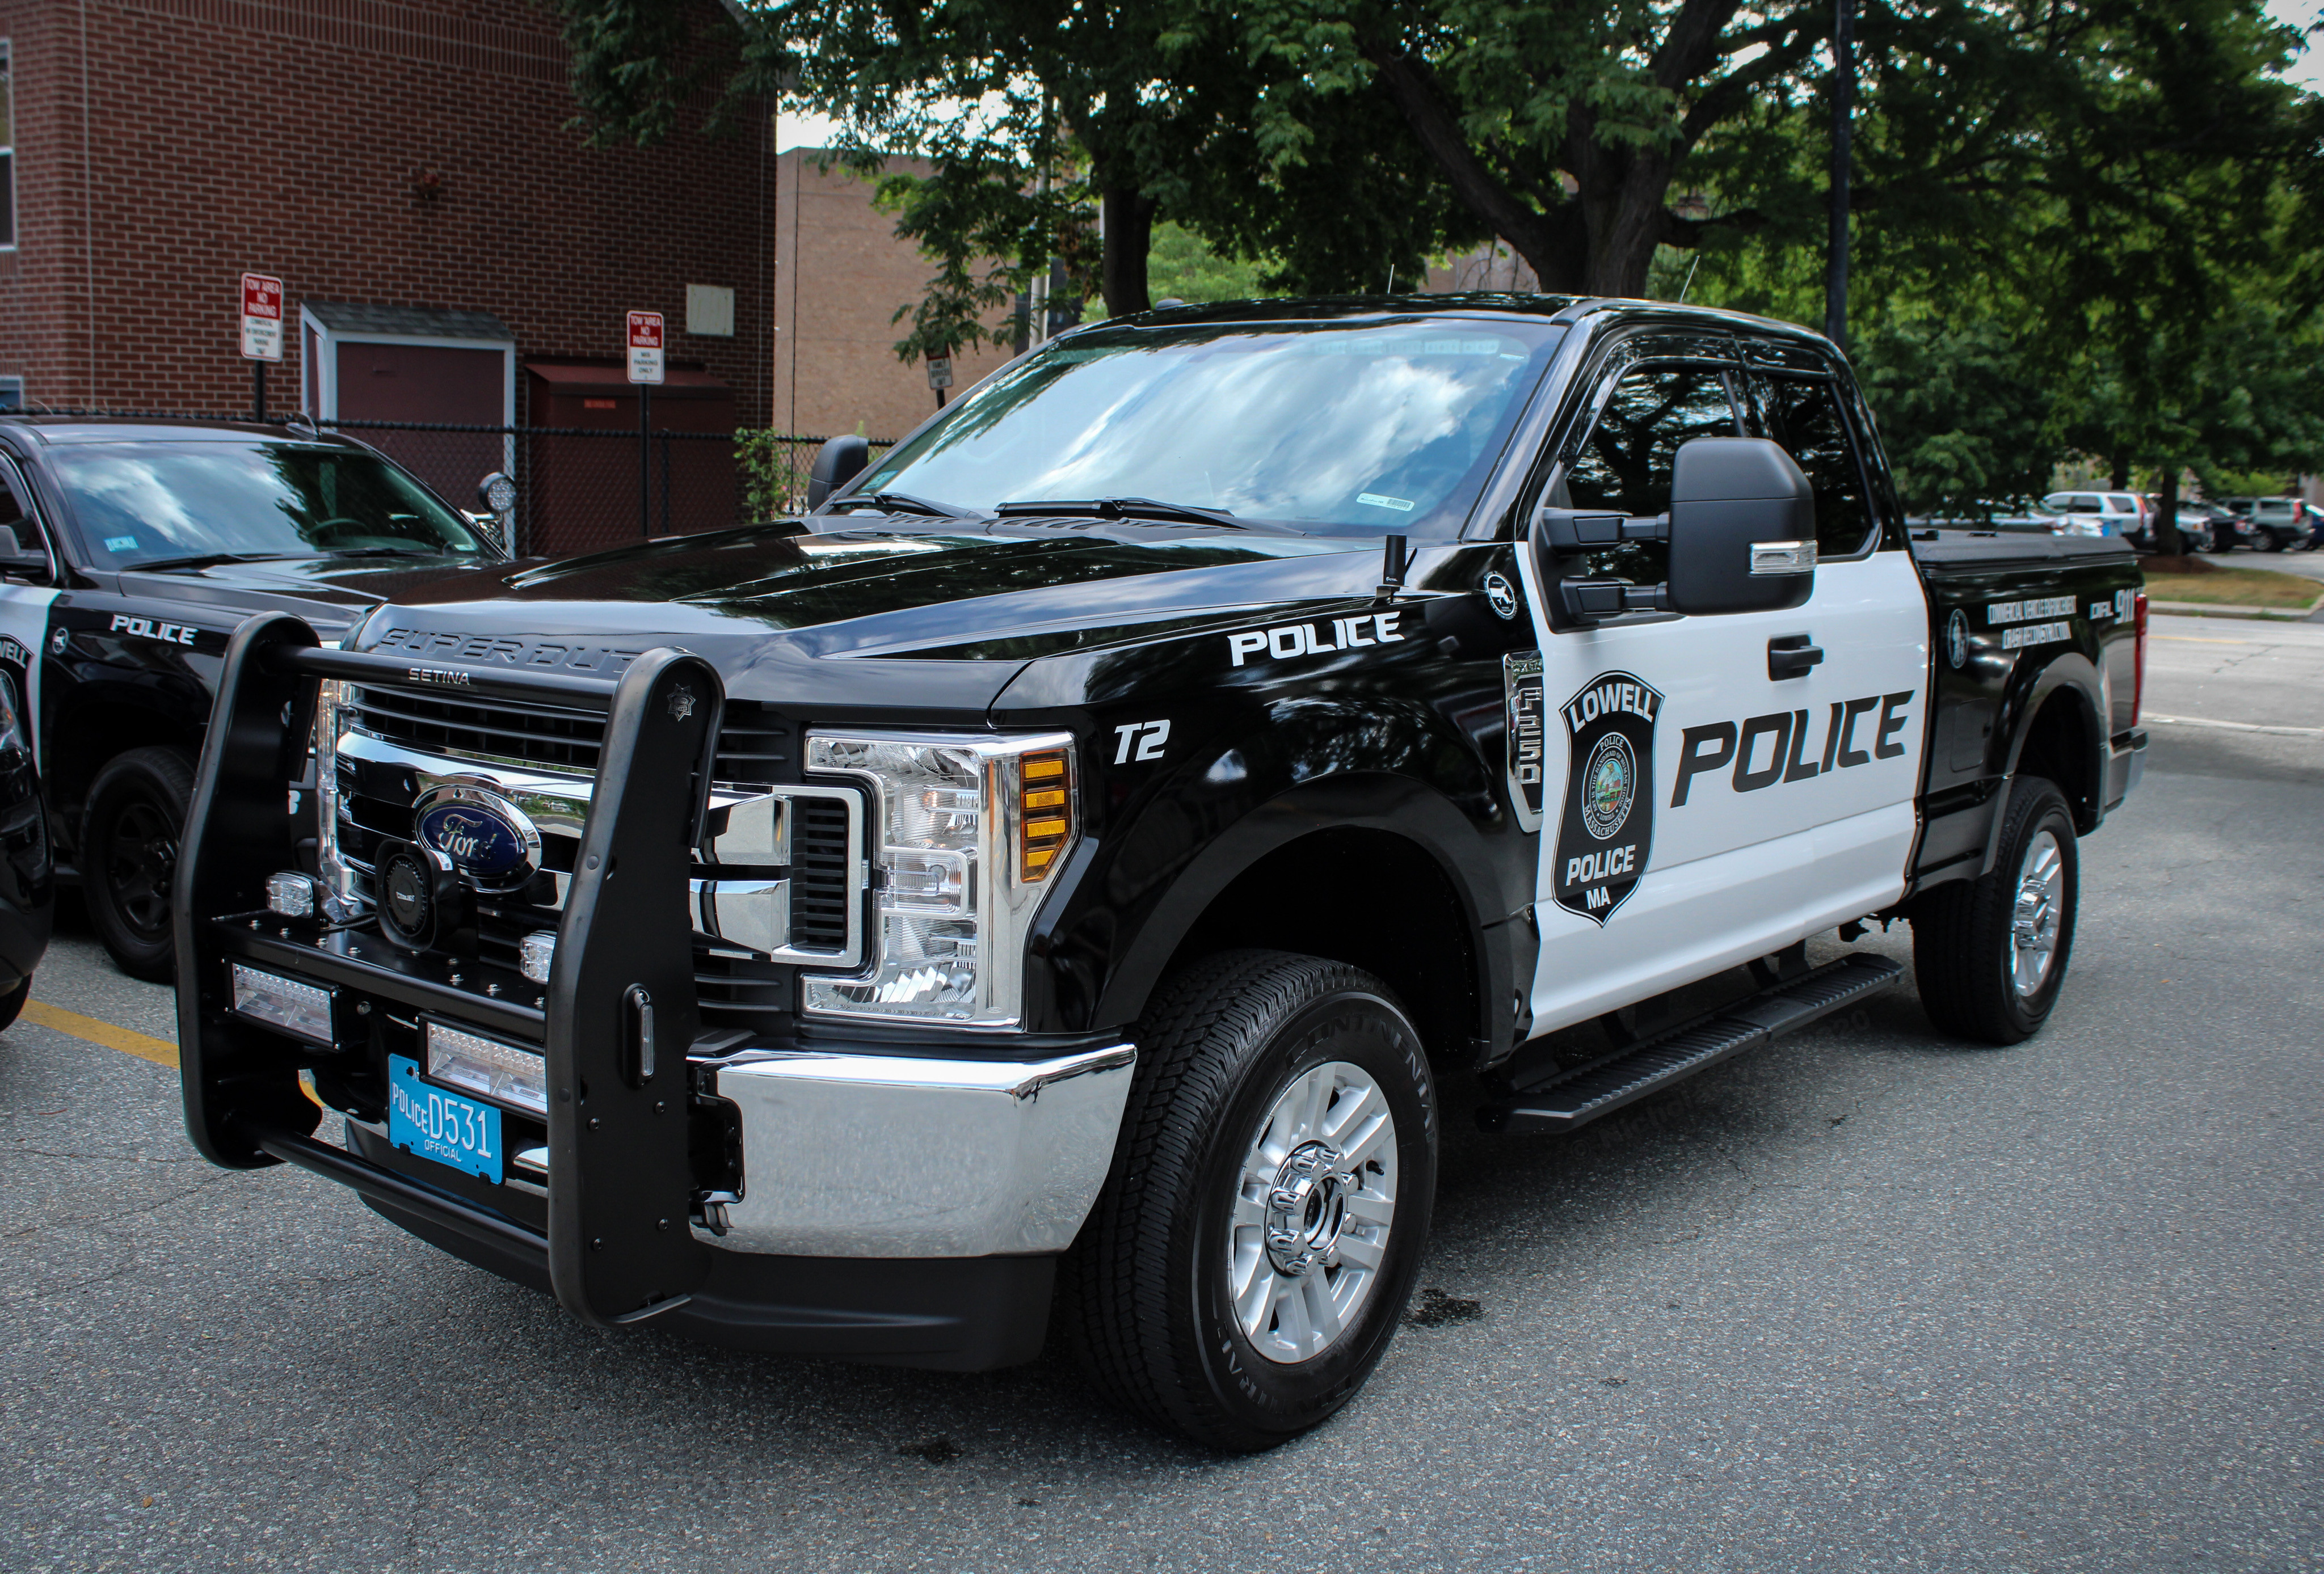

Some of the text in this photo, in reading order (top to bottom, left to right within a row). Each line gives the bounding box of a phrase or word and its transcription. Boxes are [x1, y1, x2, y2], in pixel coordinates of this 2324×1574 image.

[246, 278, 280, 294] TOW AREA
[256, 292, 268, 304] NO
[247, 301, 277, 317] PARKING
[630, 315, 660, 327] TOW AREA
[633, 335, 658, 347] PARKING
[641, 326, 650, 336] NO
[2114, 588, 2136, 624] 911
[110, 614, 199, 645] POLICE
[1227, 611, 1405, 666] POLICE
[380, 628, 642, 673] SUPER DUT
[409, 668, 470, 685] SETINA
[1569, 683, 1653, 733] LOWELL
[1114, 719, 1171, 765] T2
[1600, 736, 1624, 751] POLICE
[1670, 689, 1915, 808] POLICE
[1595, 750, 1616, 773] HANDMAID
[1585, 797, 1631, 836] MASSACHUSETTS
[439, 813, 498, 859] Ford
[1565, 845, 1636, 887] POLICE
[1586, 887, 1611, 910] MA
[1285, 1013, 1436, 1145] CONTINENTAL
[392, 1082, 492, 1159] POLICE D531
[424, 1139, 462, 1162] OFFICIAL
